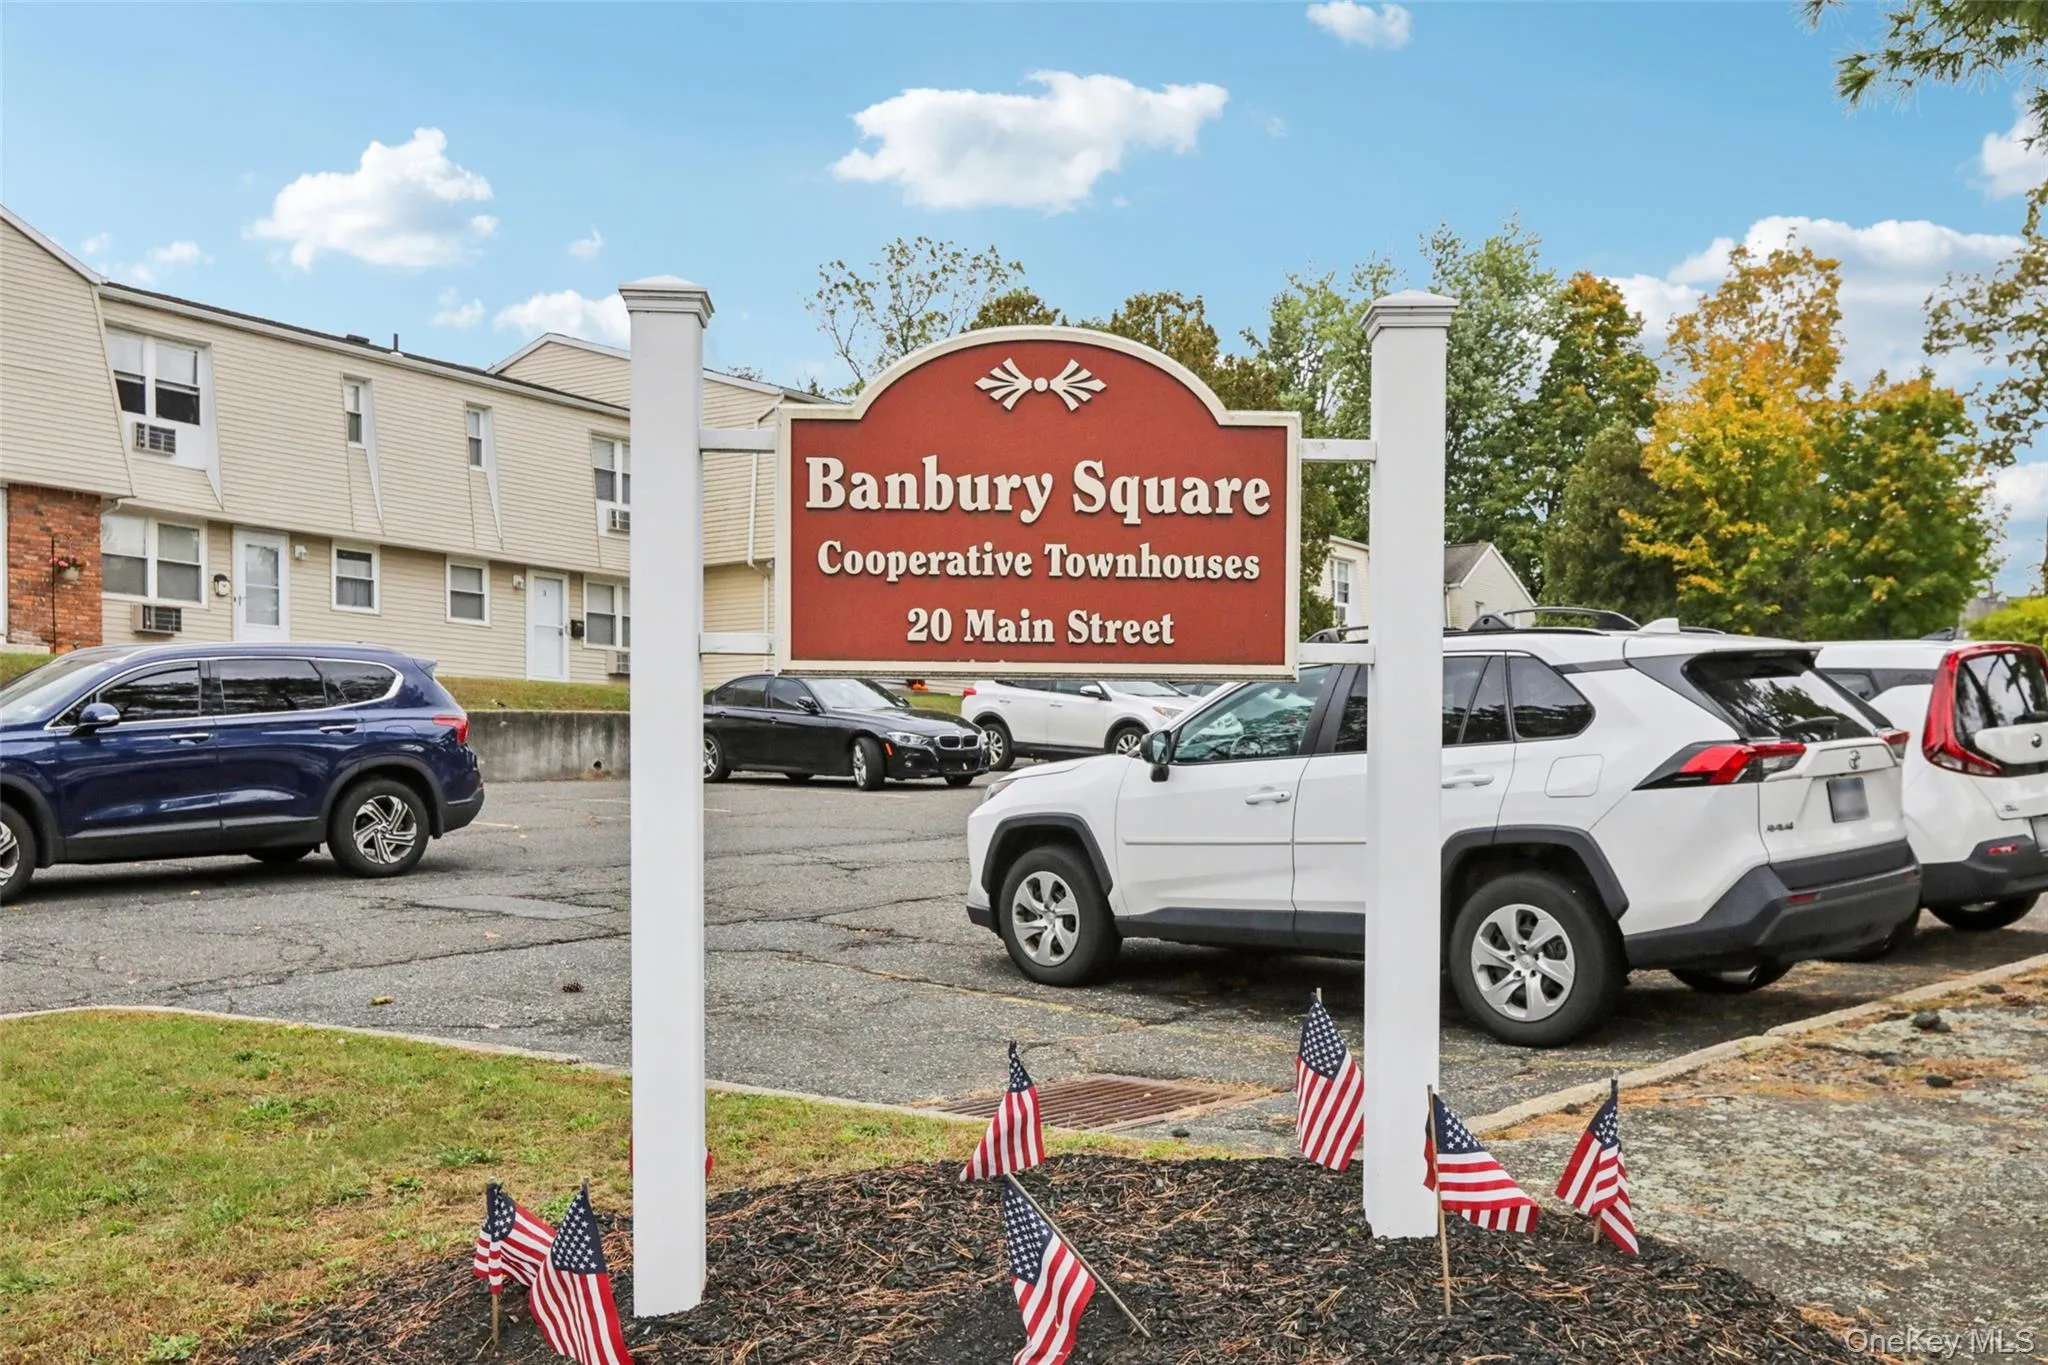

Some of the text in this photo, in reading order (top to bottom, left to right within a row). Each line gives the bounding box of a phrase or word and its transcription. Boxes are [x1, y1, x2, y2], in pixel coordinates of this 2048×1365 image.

[805, 455, 1271, 525] Banbury Square
[817, 540, 1260, 582] Cooperative Townhouses
[907, 608, 1174, 645] 20 Main Street
